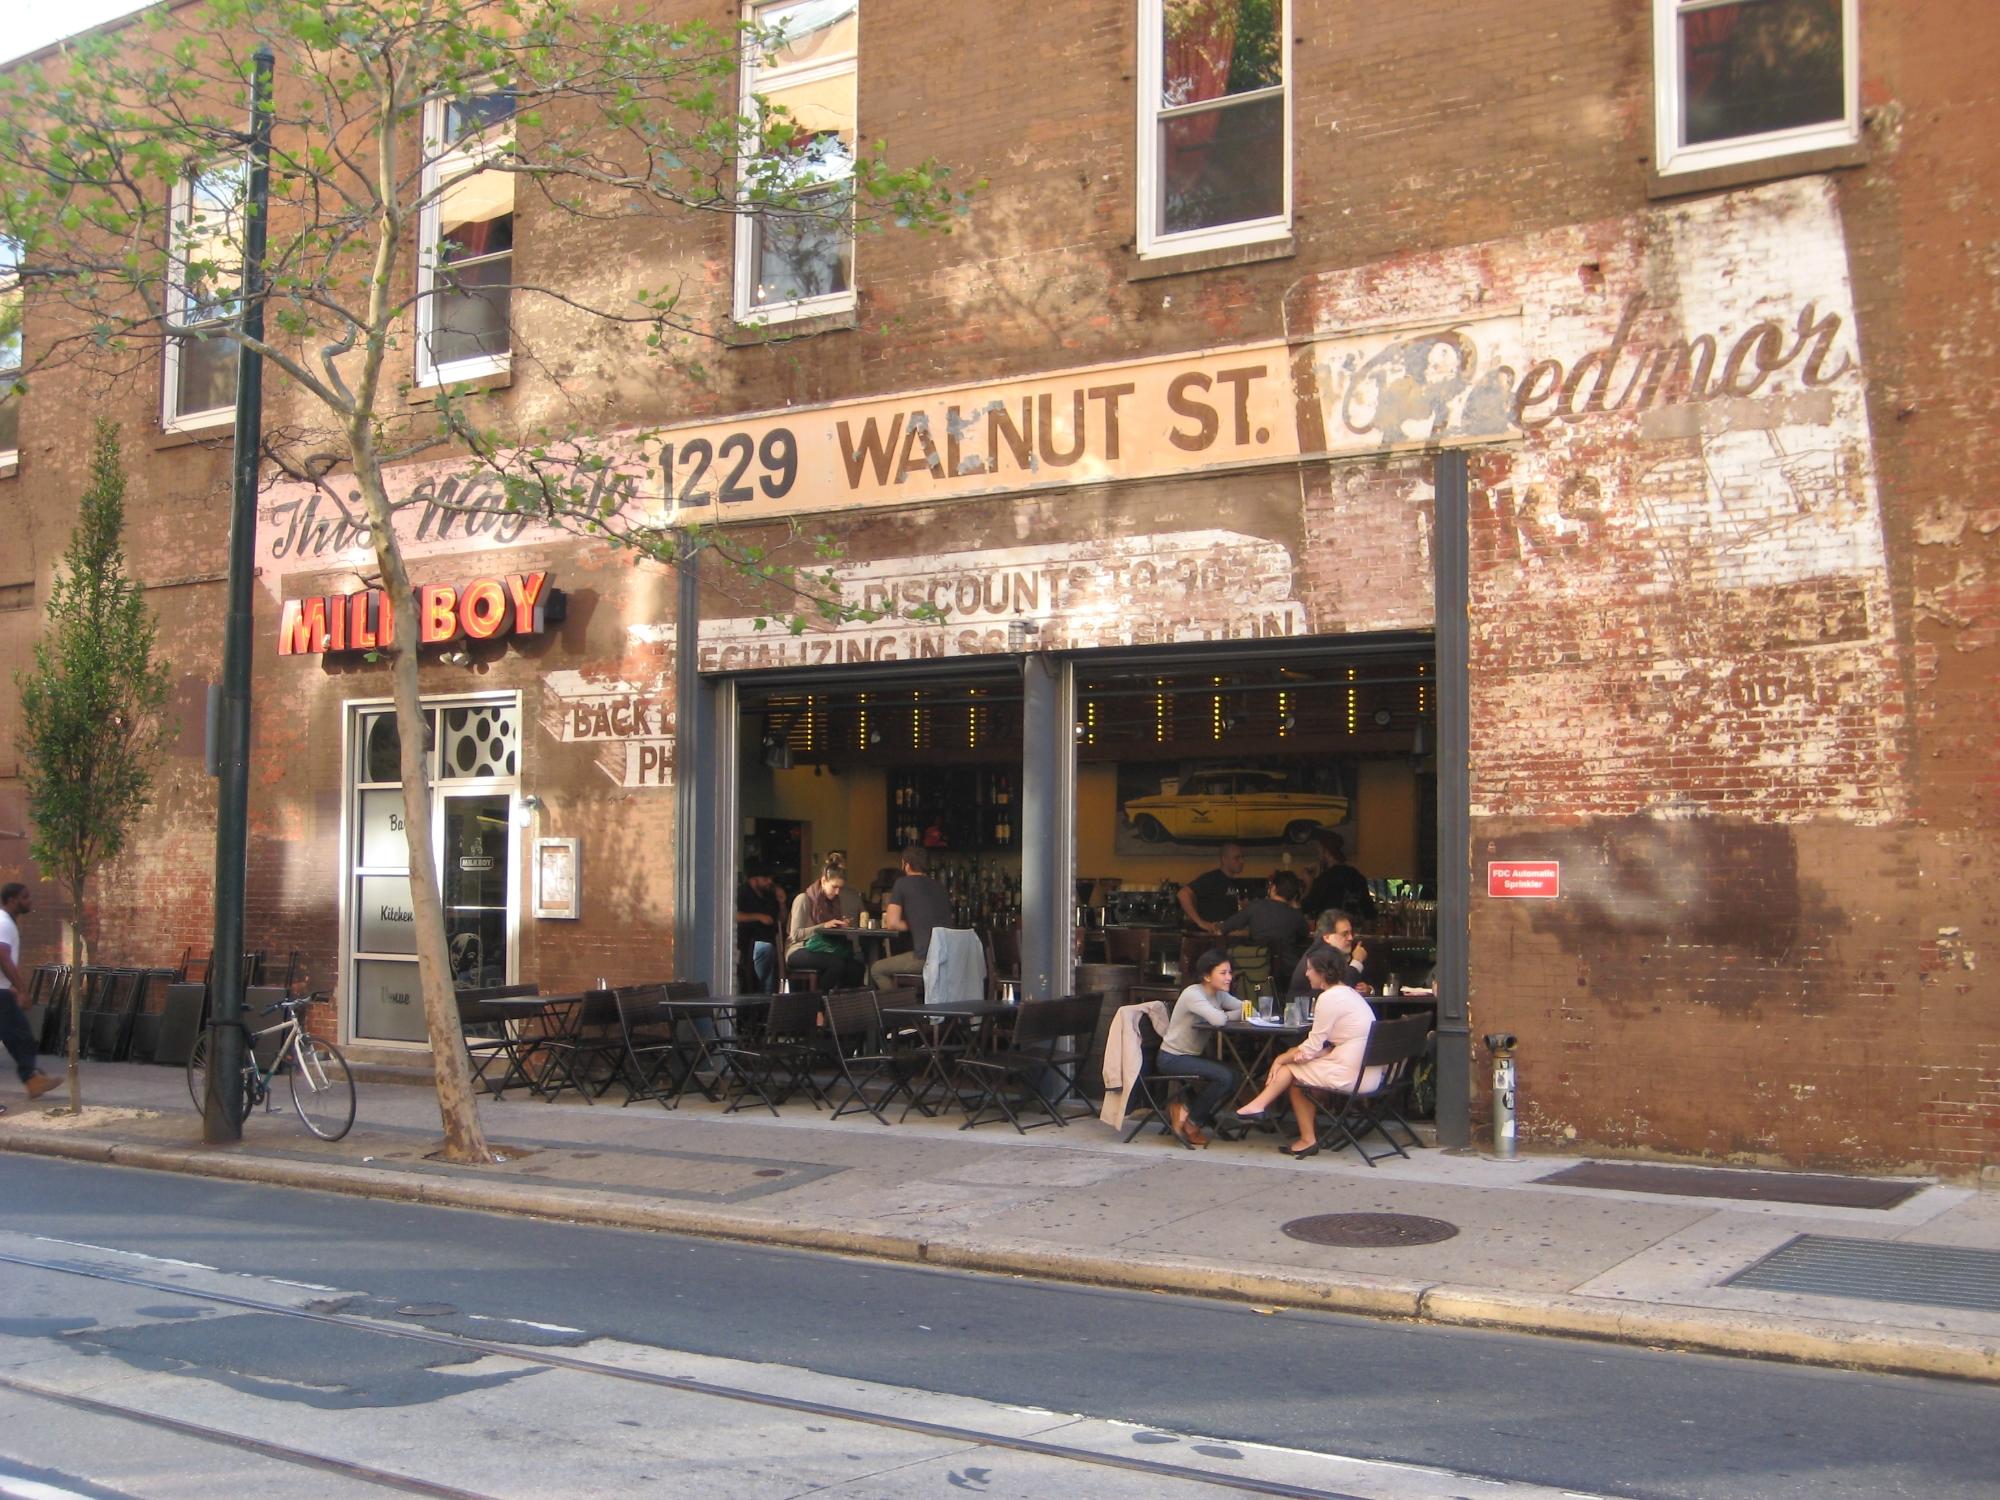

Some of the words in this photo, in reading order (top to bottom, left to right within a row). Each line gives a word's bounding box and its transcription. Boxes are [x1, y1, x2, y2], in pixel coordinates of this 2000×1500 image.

[659, 427, 798, 512] 1229
[836, 382, 1135, 490] WALNUT
[1167, 365, 1271, 452] ST.
[422, 571, 547, 644] BOY
[573, 696, 652, 738] BACK
[389, 814, 405, 831] Ba
[1492, 869, 1511, 877] FDC
[1512, 869, 1555, 877] Automatic
[1504, 880, 1543, 889] Sprinkler
[380, 905, 413, 921] Kitchen
